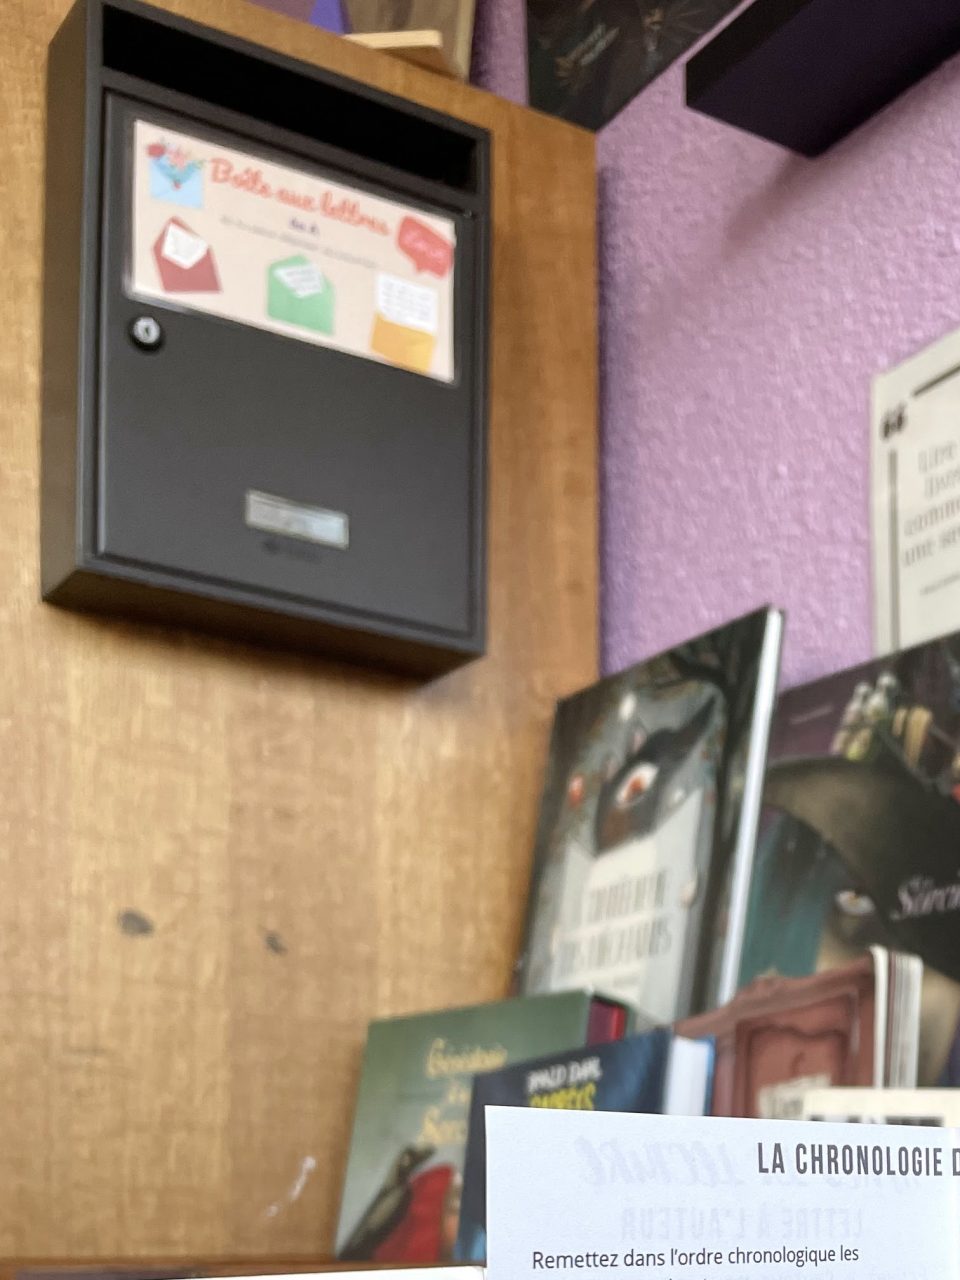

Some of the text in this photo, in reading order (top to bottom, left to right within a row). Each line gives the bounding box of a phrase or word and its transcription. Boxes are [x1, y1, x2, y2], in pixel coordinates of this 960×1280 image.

[758, 1142, 785, 1175] LA
[795, 1143, 943, 1177] CHRONOLOGIE
[532, 1250, 619, 1269] Remettez
[623, 1248, 666, 1267] dans
[728, 1246, 837, 1268] chronologique
[839, 1244, 860, 1261] les
